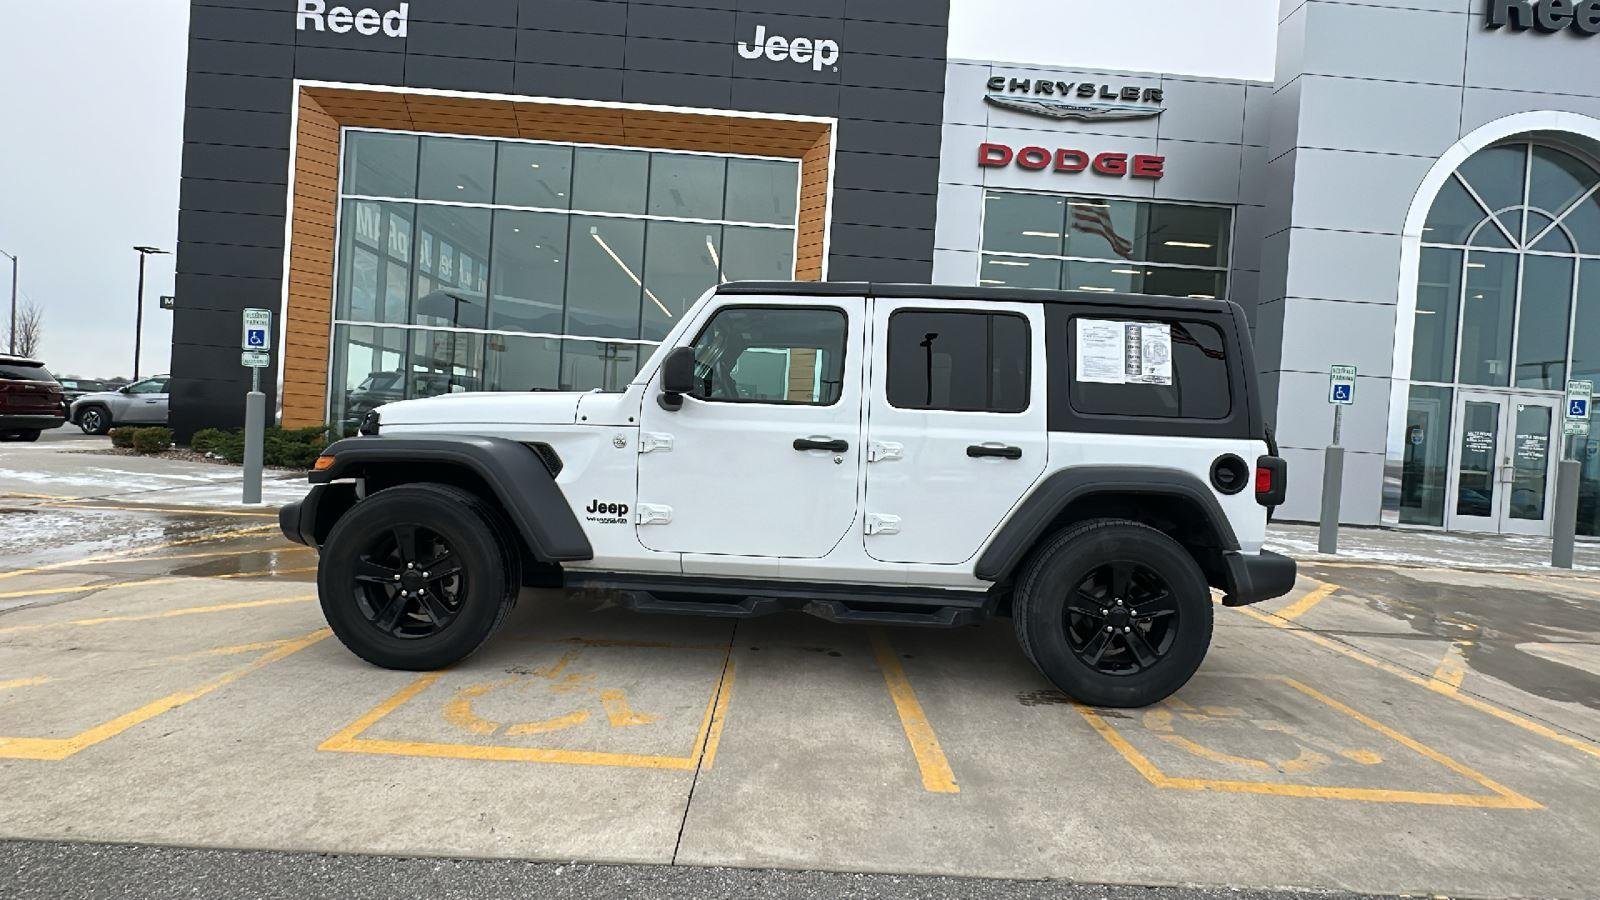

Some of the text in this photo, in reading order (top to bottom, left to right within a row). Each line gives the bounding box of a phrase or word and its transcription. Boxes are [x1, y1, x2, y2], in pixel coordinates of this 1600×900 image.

[296, 0, 409, 38] Reed
[737, 25, 839, 71] Jeep
[986, 76, 1165, 101] CHRYSLER
[977, 142, 1166, 179] DODGE
[586, 499, 629, 517] Jeep
